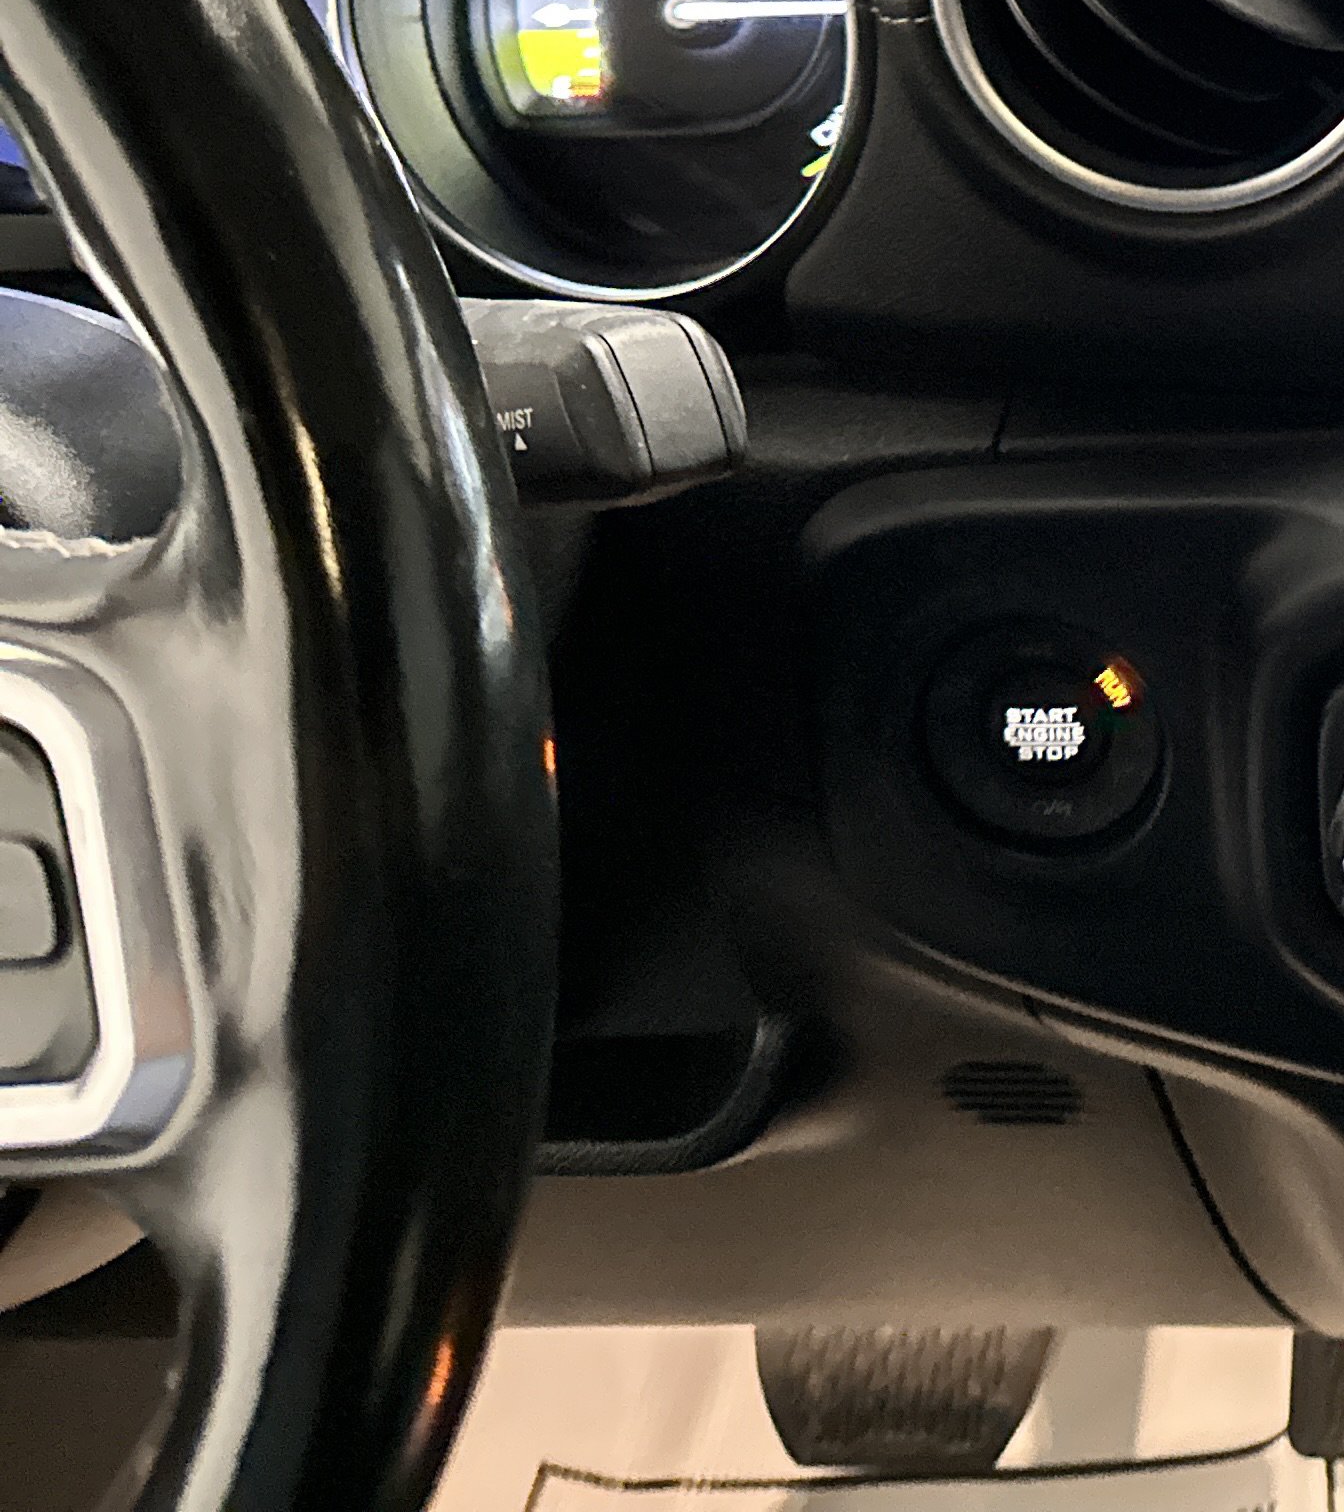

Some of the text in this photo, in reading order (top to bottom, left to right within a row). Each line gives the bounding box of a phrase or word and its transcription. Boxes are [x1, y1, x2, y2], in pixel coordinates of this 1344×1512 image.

[497, 408, 534, 431] MIST
[1005, 706, 1078, 723] START
[1003, 726, 1086, 742] ENGINE
[1018, 745, 1079, 761] STOP
